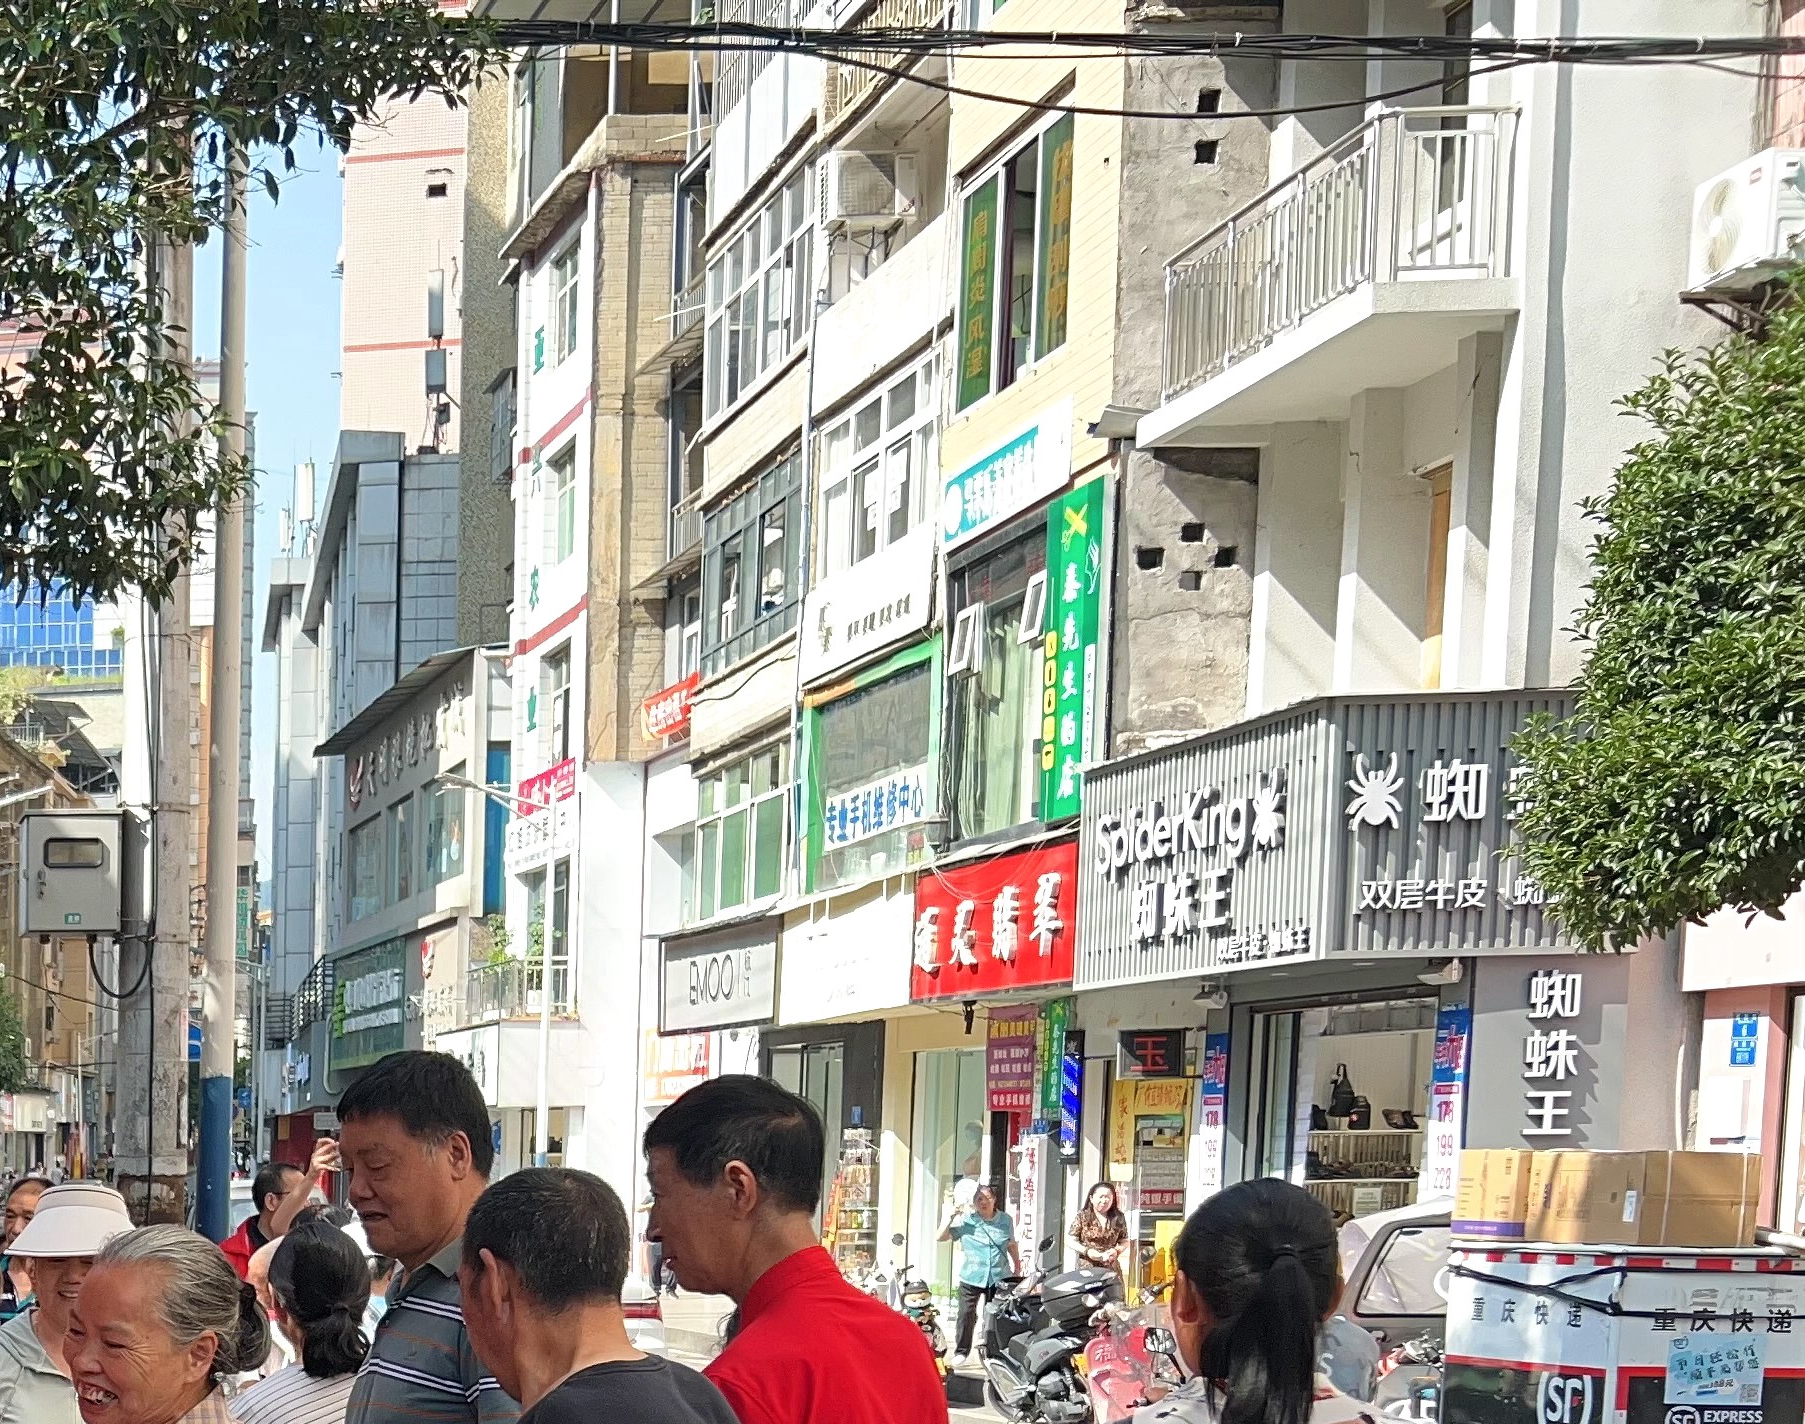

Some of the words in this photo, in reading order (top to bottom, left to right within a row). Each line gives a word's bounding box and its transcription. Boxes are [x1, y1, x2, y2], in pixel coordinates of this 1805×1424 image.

[826, 775, 924, 845] 专业手机维修中心
[1096, 785, 1247, 884] SpiderKing
[1130, 868, 1231, 941] 蜘蛛王
[1130, 1036, 1169, 1072] 玉
[1520, 969, 1582, 1136] 蜘蛛王
[1472, 1297, 1582, 1328] 重庆快递
[1652, 1307, 1793, 1334] 重庆快递
[1703, 1410, 1763, 1424] EXPRESS
